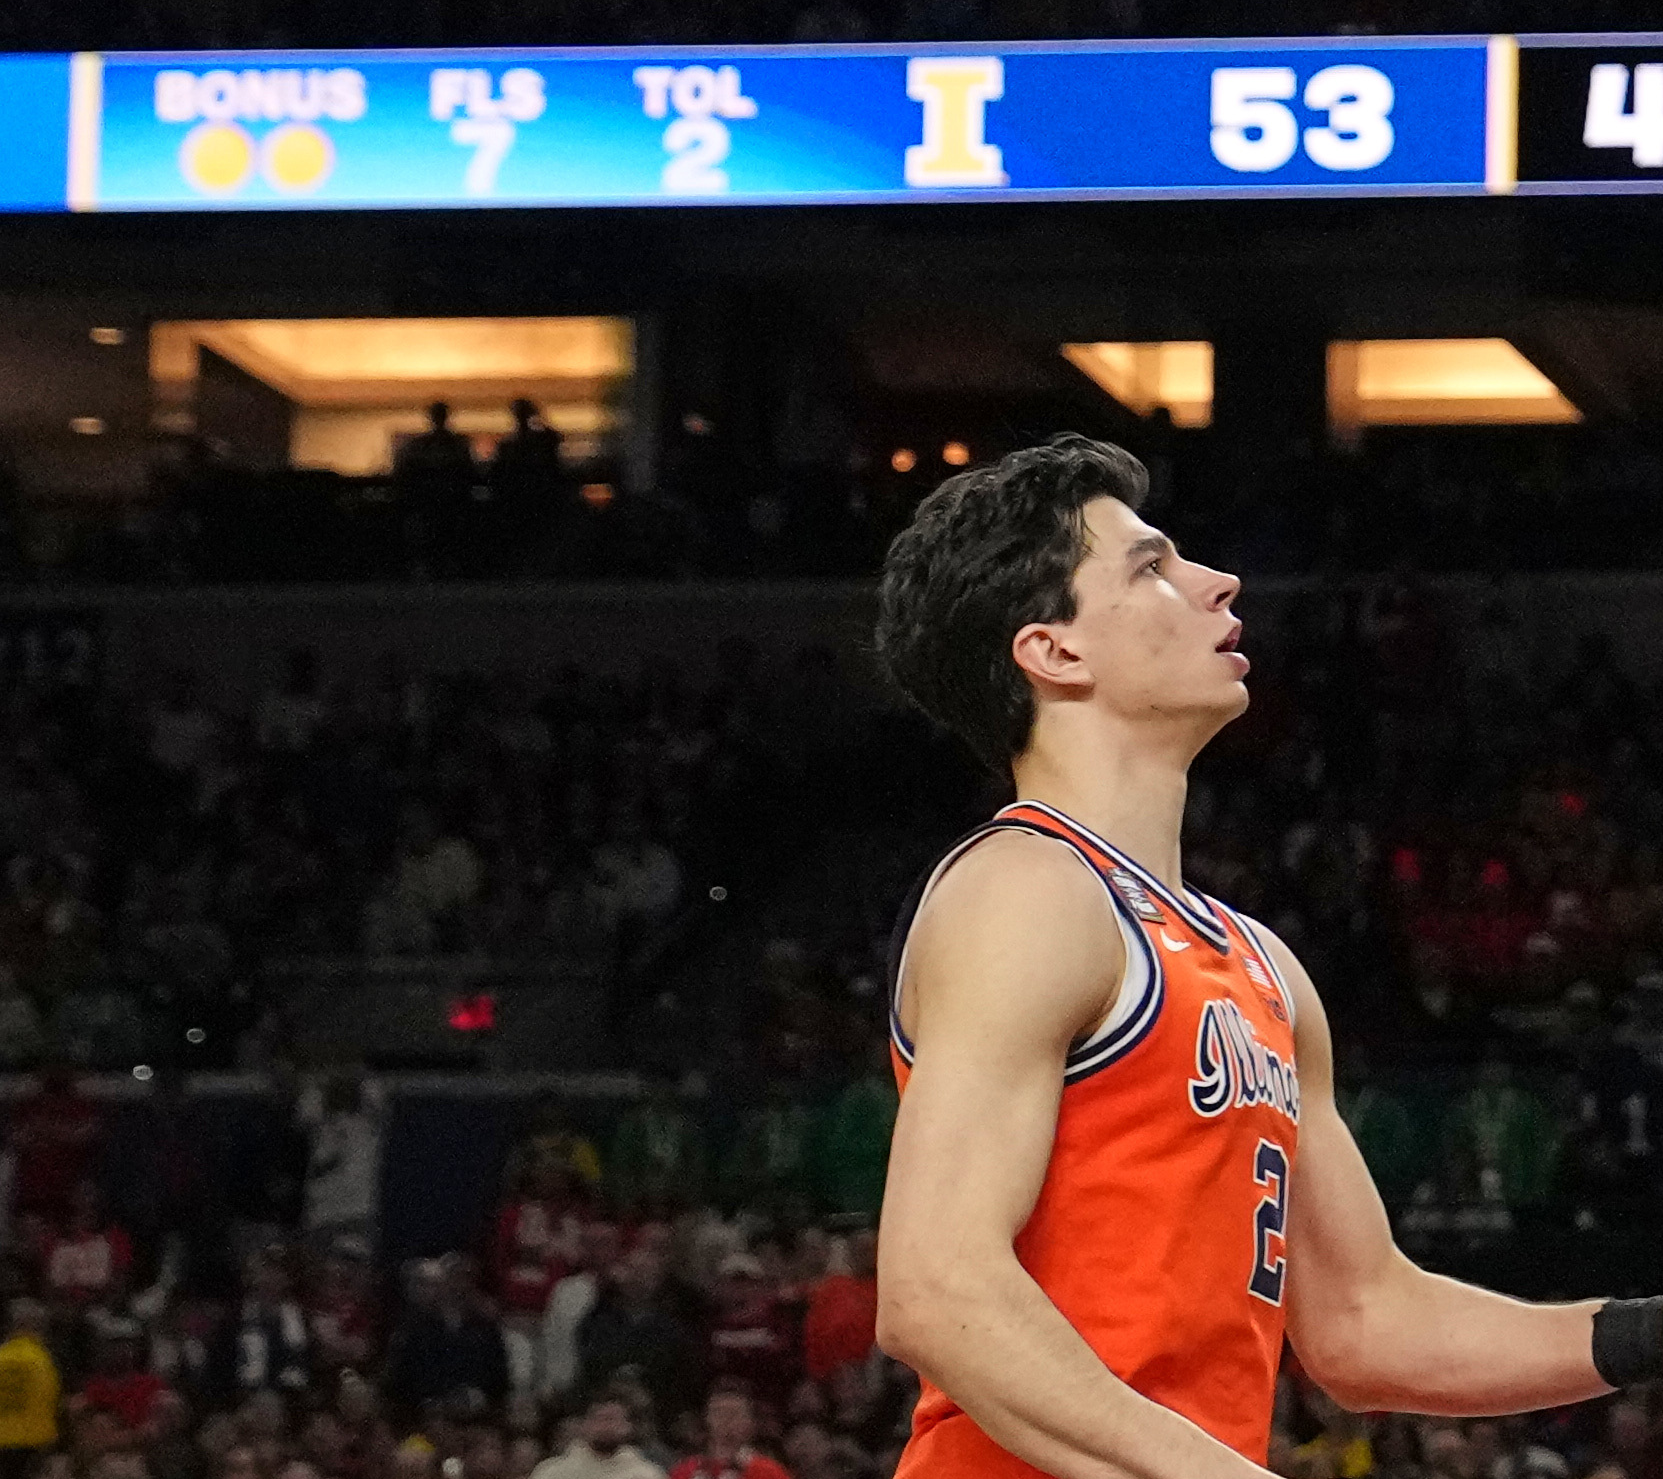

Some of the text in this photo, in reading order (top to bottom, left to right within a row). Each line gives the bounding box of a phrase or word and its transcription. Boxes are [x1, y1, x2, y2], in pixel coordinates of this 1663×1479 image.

[153, 67, 368, 123] BONUS
[428, 66, 547, 122] FLS
[632, 64, 758, 120] TOL
[1208, 65, 1395, 172] 53
[449, 117, 518, 198] 7
[660, 115, 733, 196] 2
